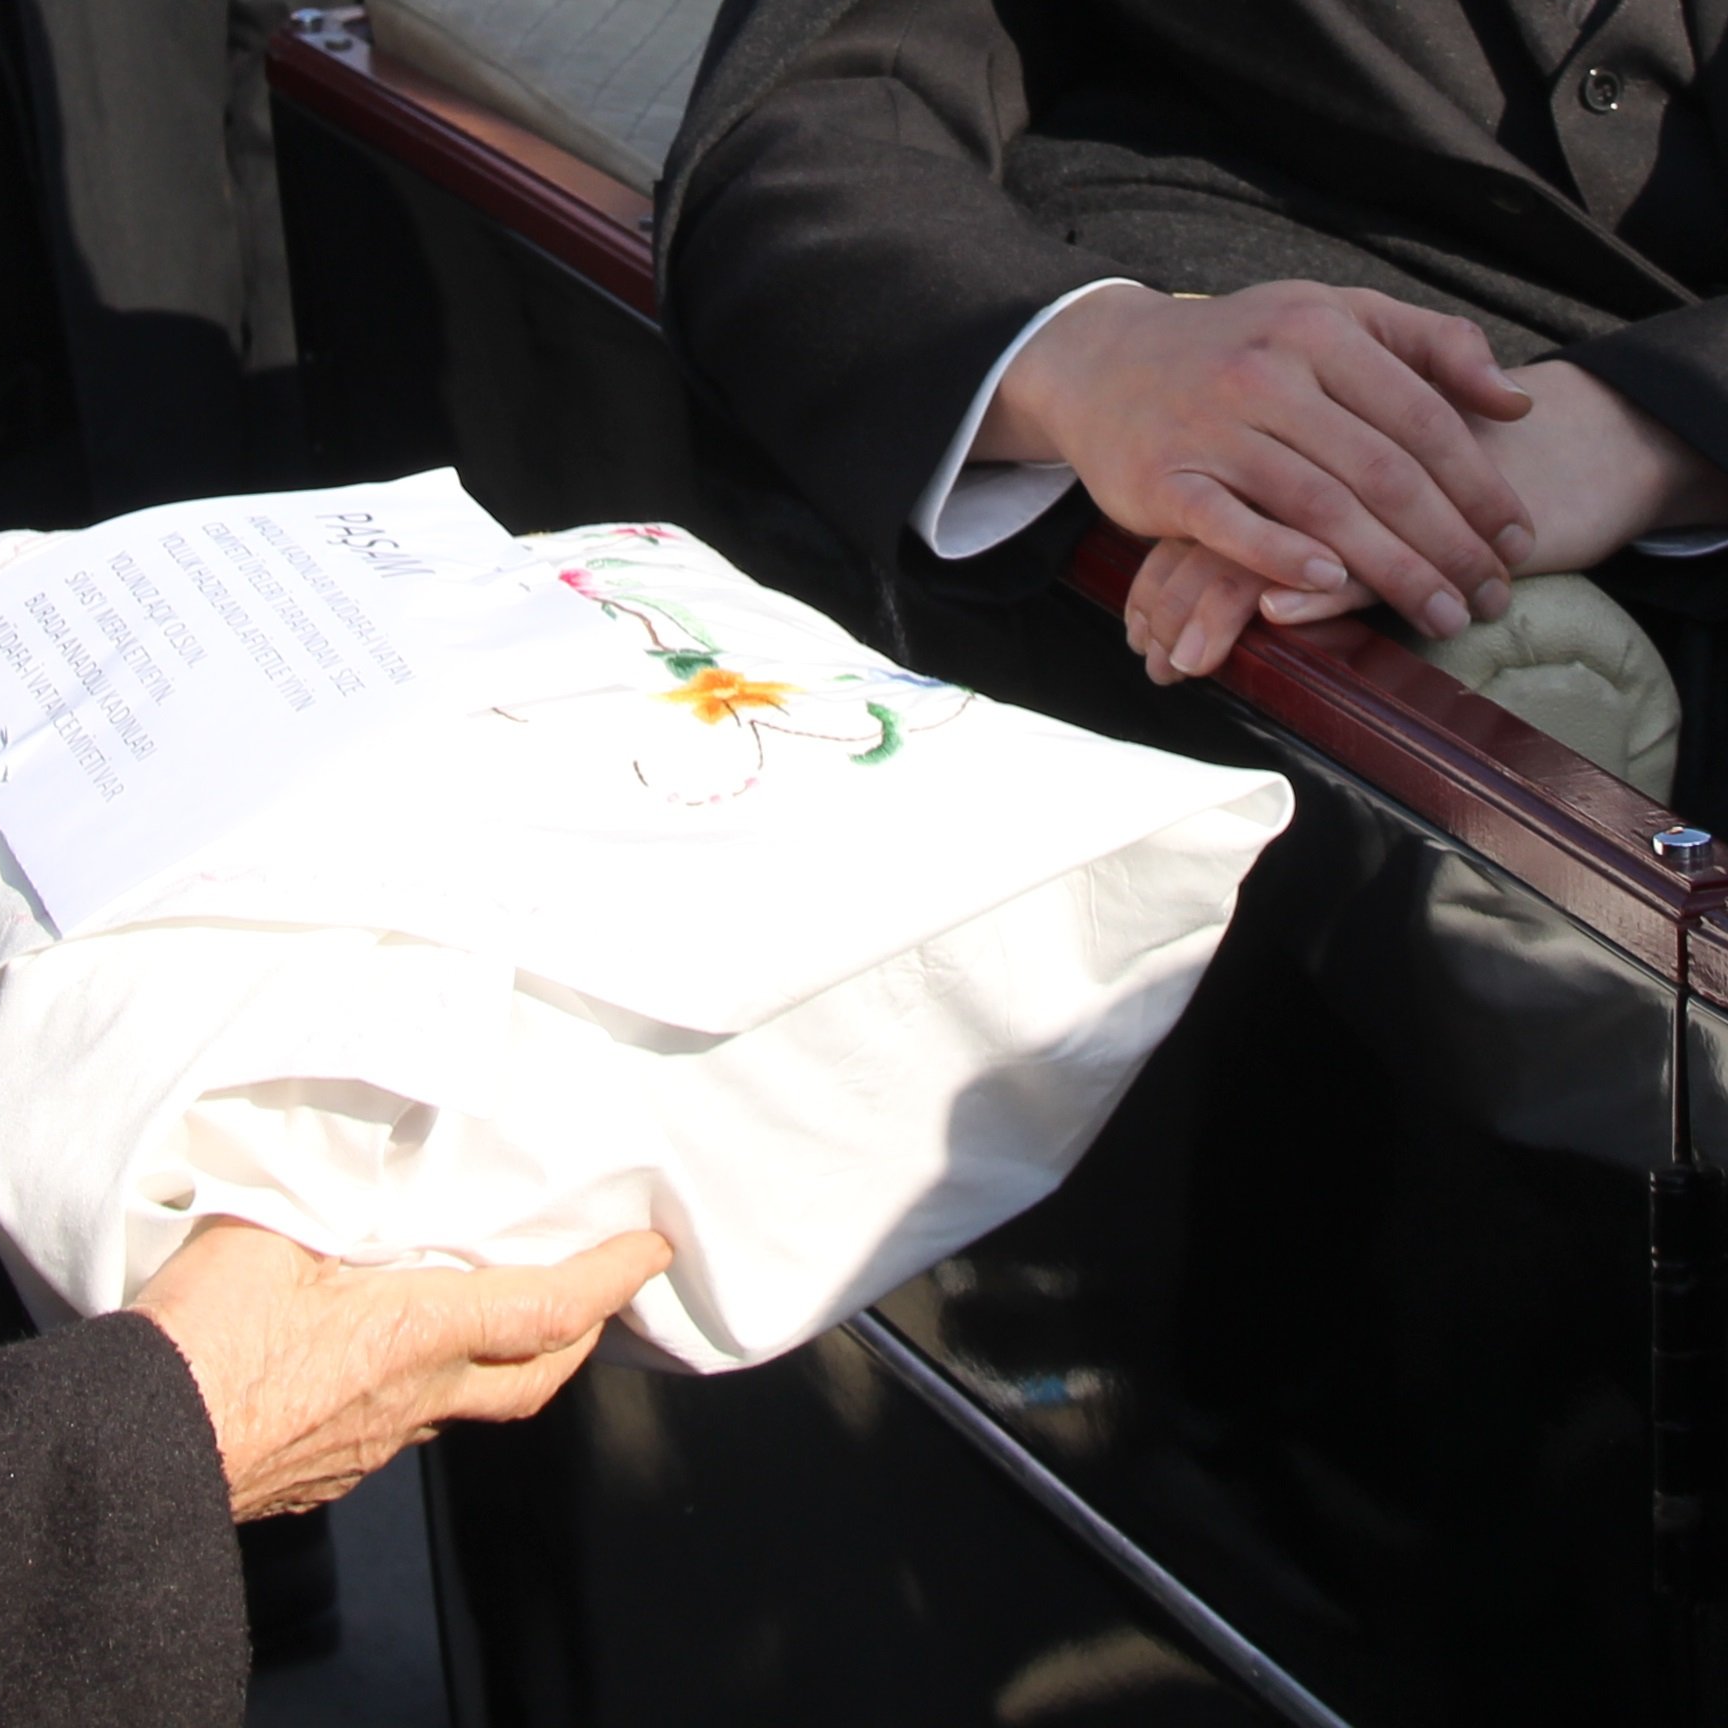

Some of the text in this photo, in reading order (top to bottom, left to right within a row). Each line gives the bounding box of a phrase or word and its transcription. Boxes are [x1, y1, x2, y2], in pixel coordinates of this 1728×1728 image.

[318, 512, 436, 580] PAŞAM
[105, 549, 162, 604] YOLUNUZ
[142, 598, 179, 627] AÇIK
[92, 607, 140, 654] MERAK
[268, 596, 345, 670] TARAFINDAN
[327, 666, 366, 698] SİZE
[366, 639, 417, 686] VATAN
[21, 591, 159, 763] BURADA ANADOLU KADINLARI
[26, 671, 70, 721] VATAN
[90, 764, 127, 804] VAR
